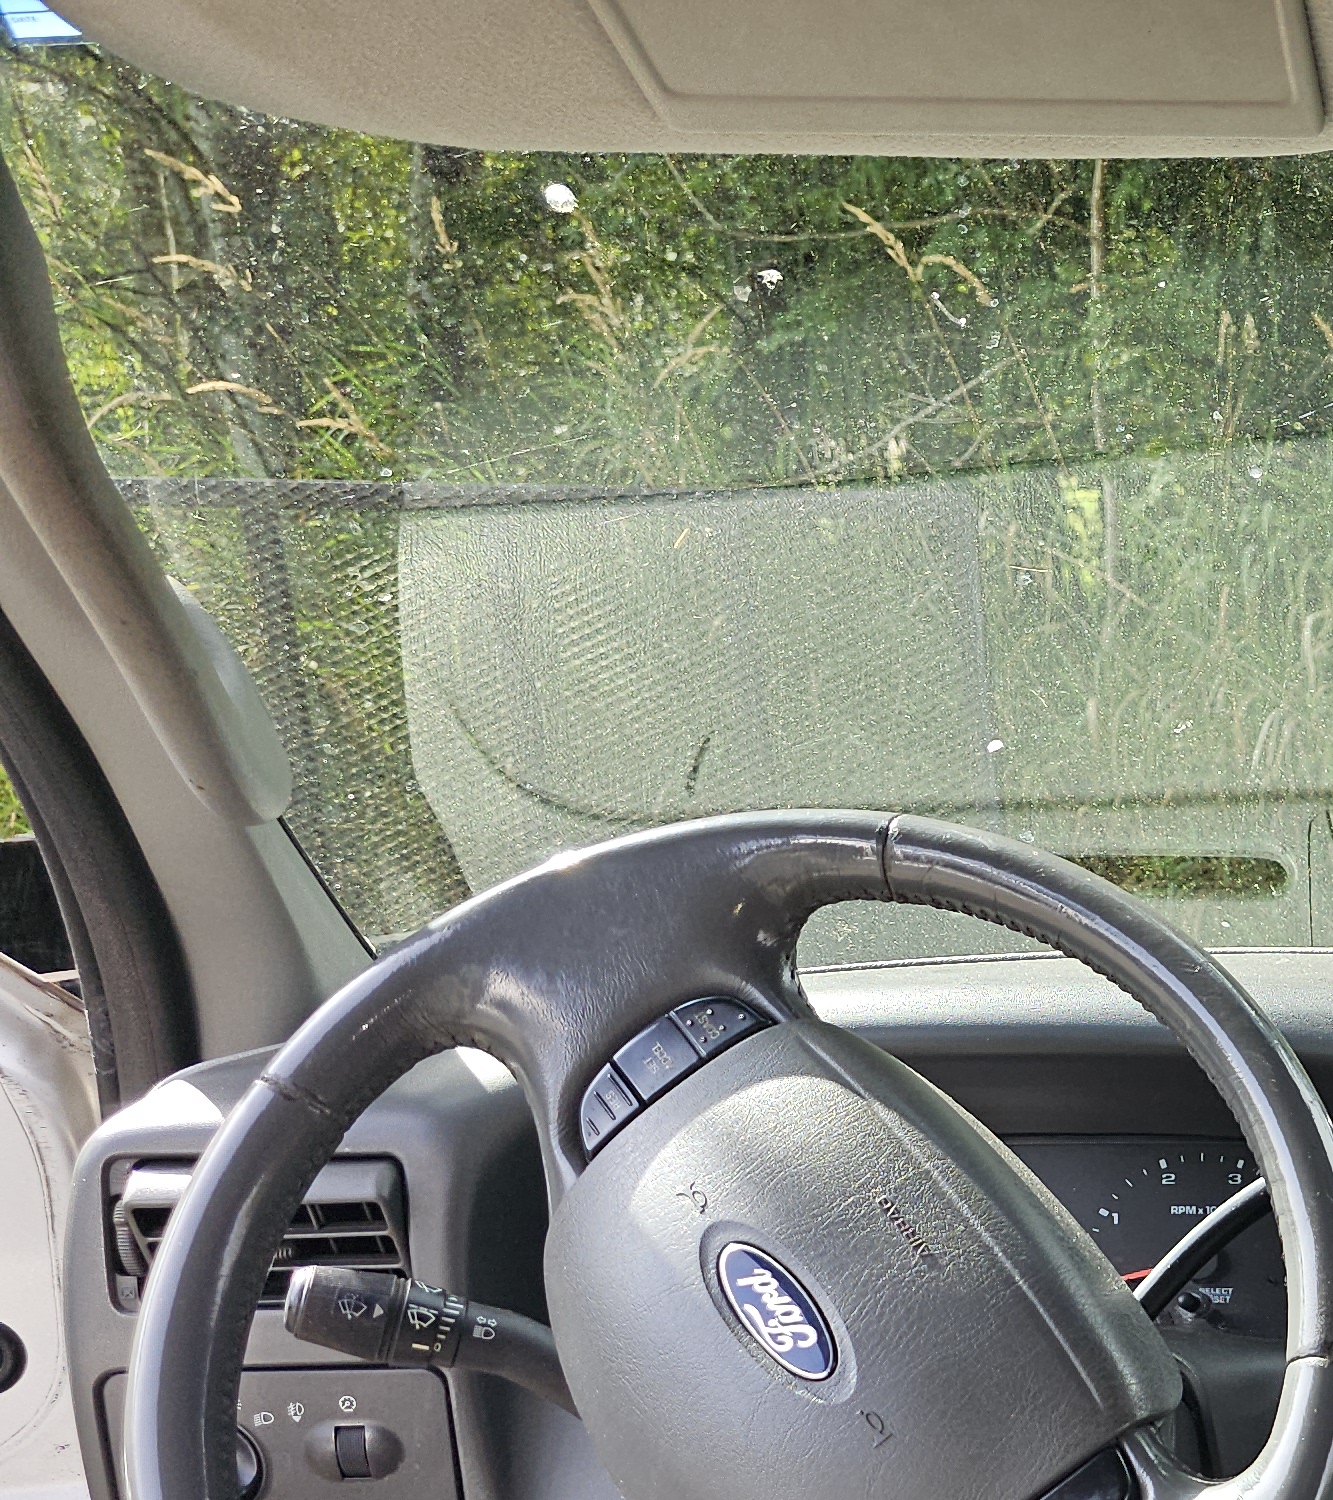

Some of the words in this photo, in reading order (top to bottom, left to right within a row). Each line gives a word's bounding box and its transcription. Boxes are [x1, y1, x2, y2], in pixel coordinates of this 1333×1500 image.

[694, 1012, 720, 1040] COAST
[1161, 1173, 1176, 1185] 2
[1227, 1173, 1242, 1185] 3
[1170, 1206, 1197, 1215] RPM
[1111, 1212, 1119, 1225] 1
[1199, 1287, 1234, 1295] SELECT
[736, 1268, 818, 1352] Ford
